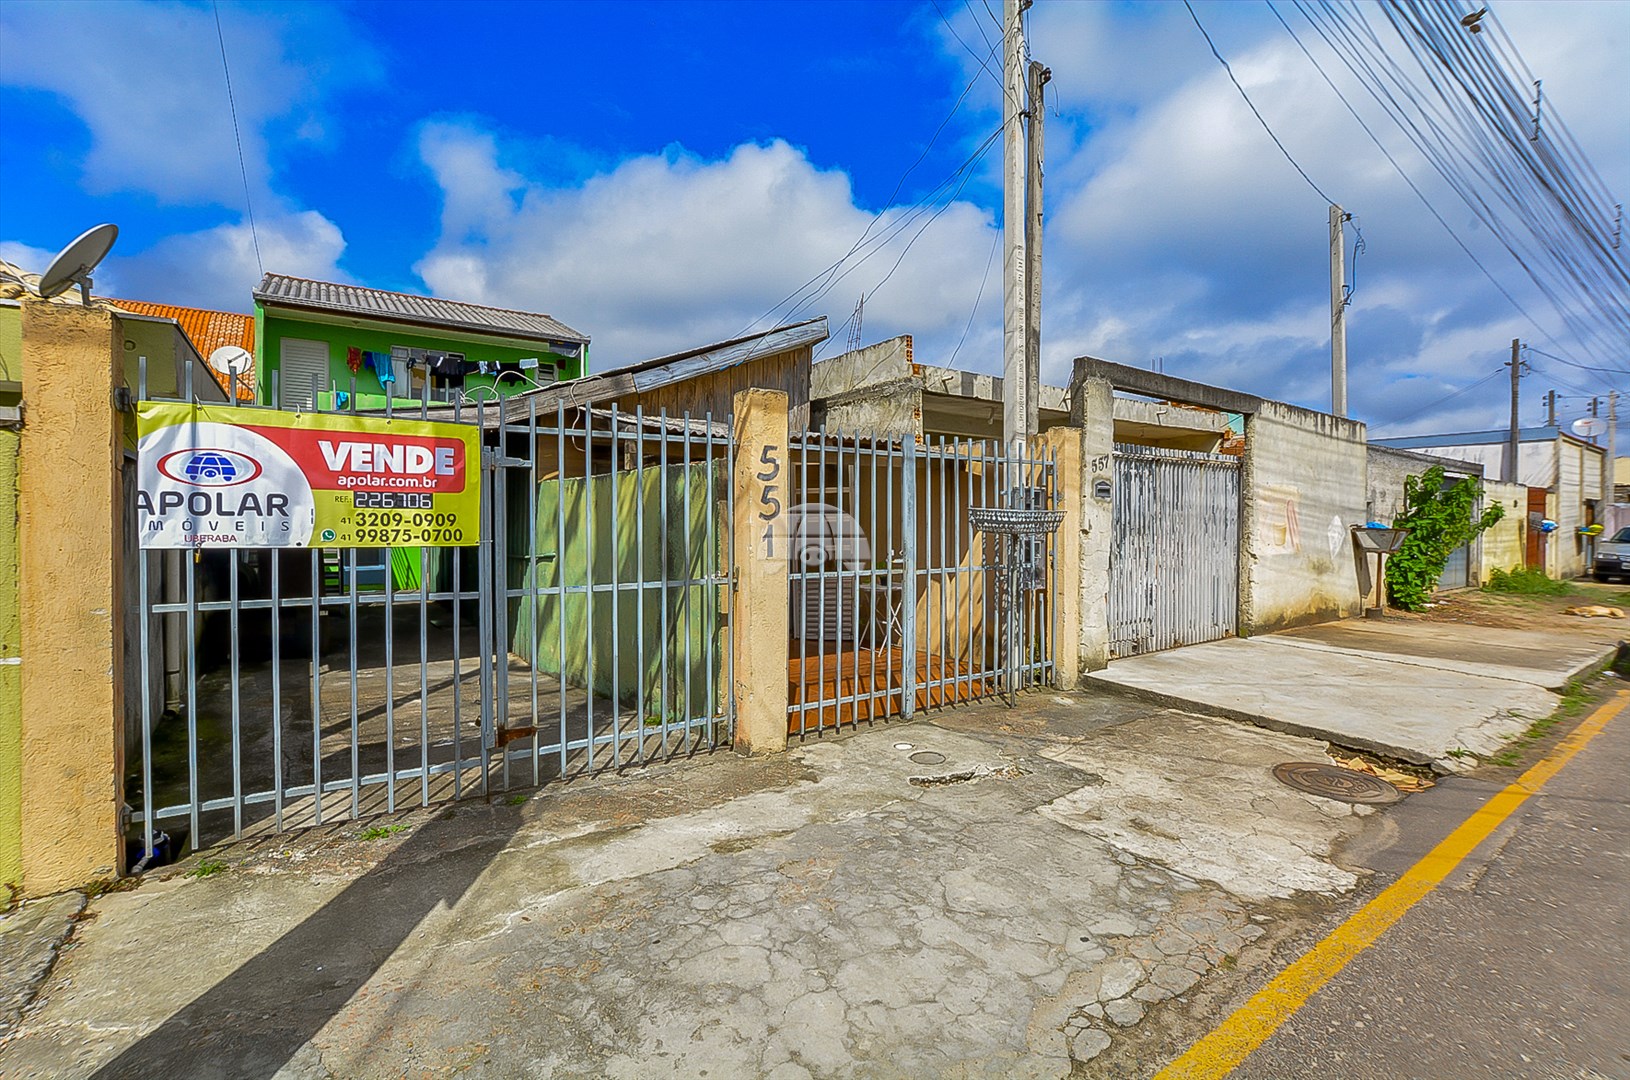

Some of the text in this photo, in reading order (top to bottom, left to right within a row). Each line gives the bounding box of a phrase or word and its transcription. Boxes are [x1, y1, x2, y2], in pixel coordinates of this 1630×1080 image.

[317, 440, 455, 476] VENDE
[1091, 453, 1110, 473] 557
[337, 474, 437, 488] apolar.com.br
[137, 489, 290, 517] APOLAR
[355, 492, 432, 508] 226706
[757, 445, 780, 557] 551
[340, 512, 457, 527] 41 3209-0909
[184, 534, 238, 543] UBERABA
[340, 529, 463, 543] 41 99875-0700
